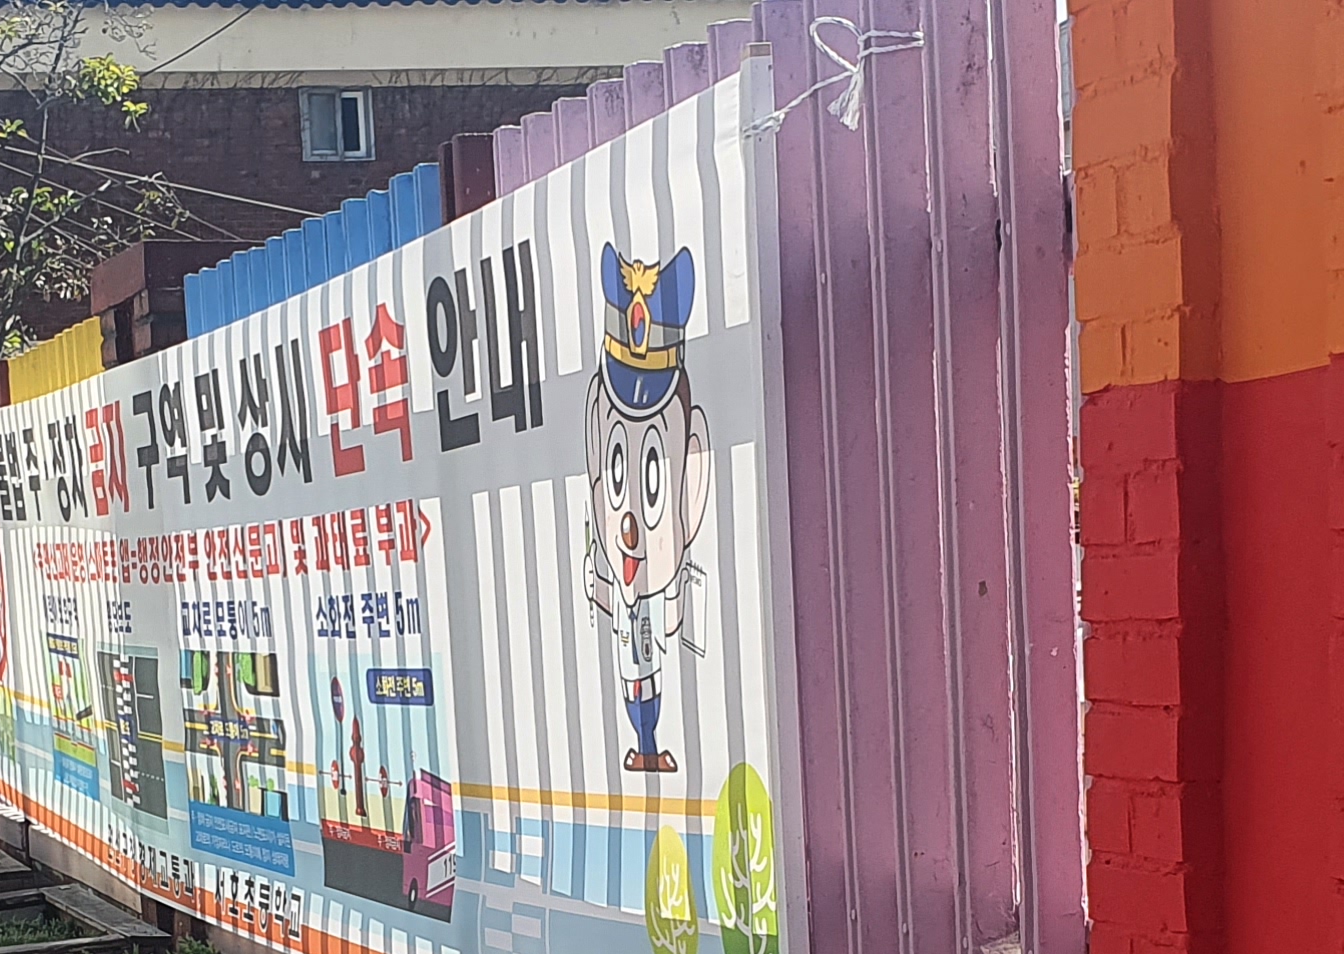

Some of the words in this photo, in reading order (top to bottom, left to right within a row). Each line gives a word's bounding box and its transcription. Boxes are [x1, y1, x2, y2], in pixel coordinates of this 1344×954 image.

[85, 399, 129, 517] 금지
[132, 381, 192, 510] 구역
[194, 368, 231, 503] 및
[238, 338, 313, 497] 상시
[318, 302, 414, 477] 단속
[426, 239, 544, 453] 안내
[289, 517, 309, 576] 및
[311, 508, 371, 573] 과태료
[316, 594, 357, 639] 소화전
[360, 591, 391, 639] 주변
[395, 591, 421, 636] 5m
[215, 867, 302, 939] 서호초등학교
